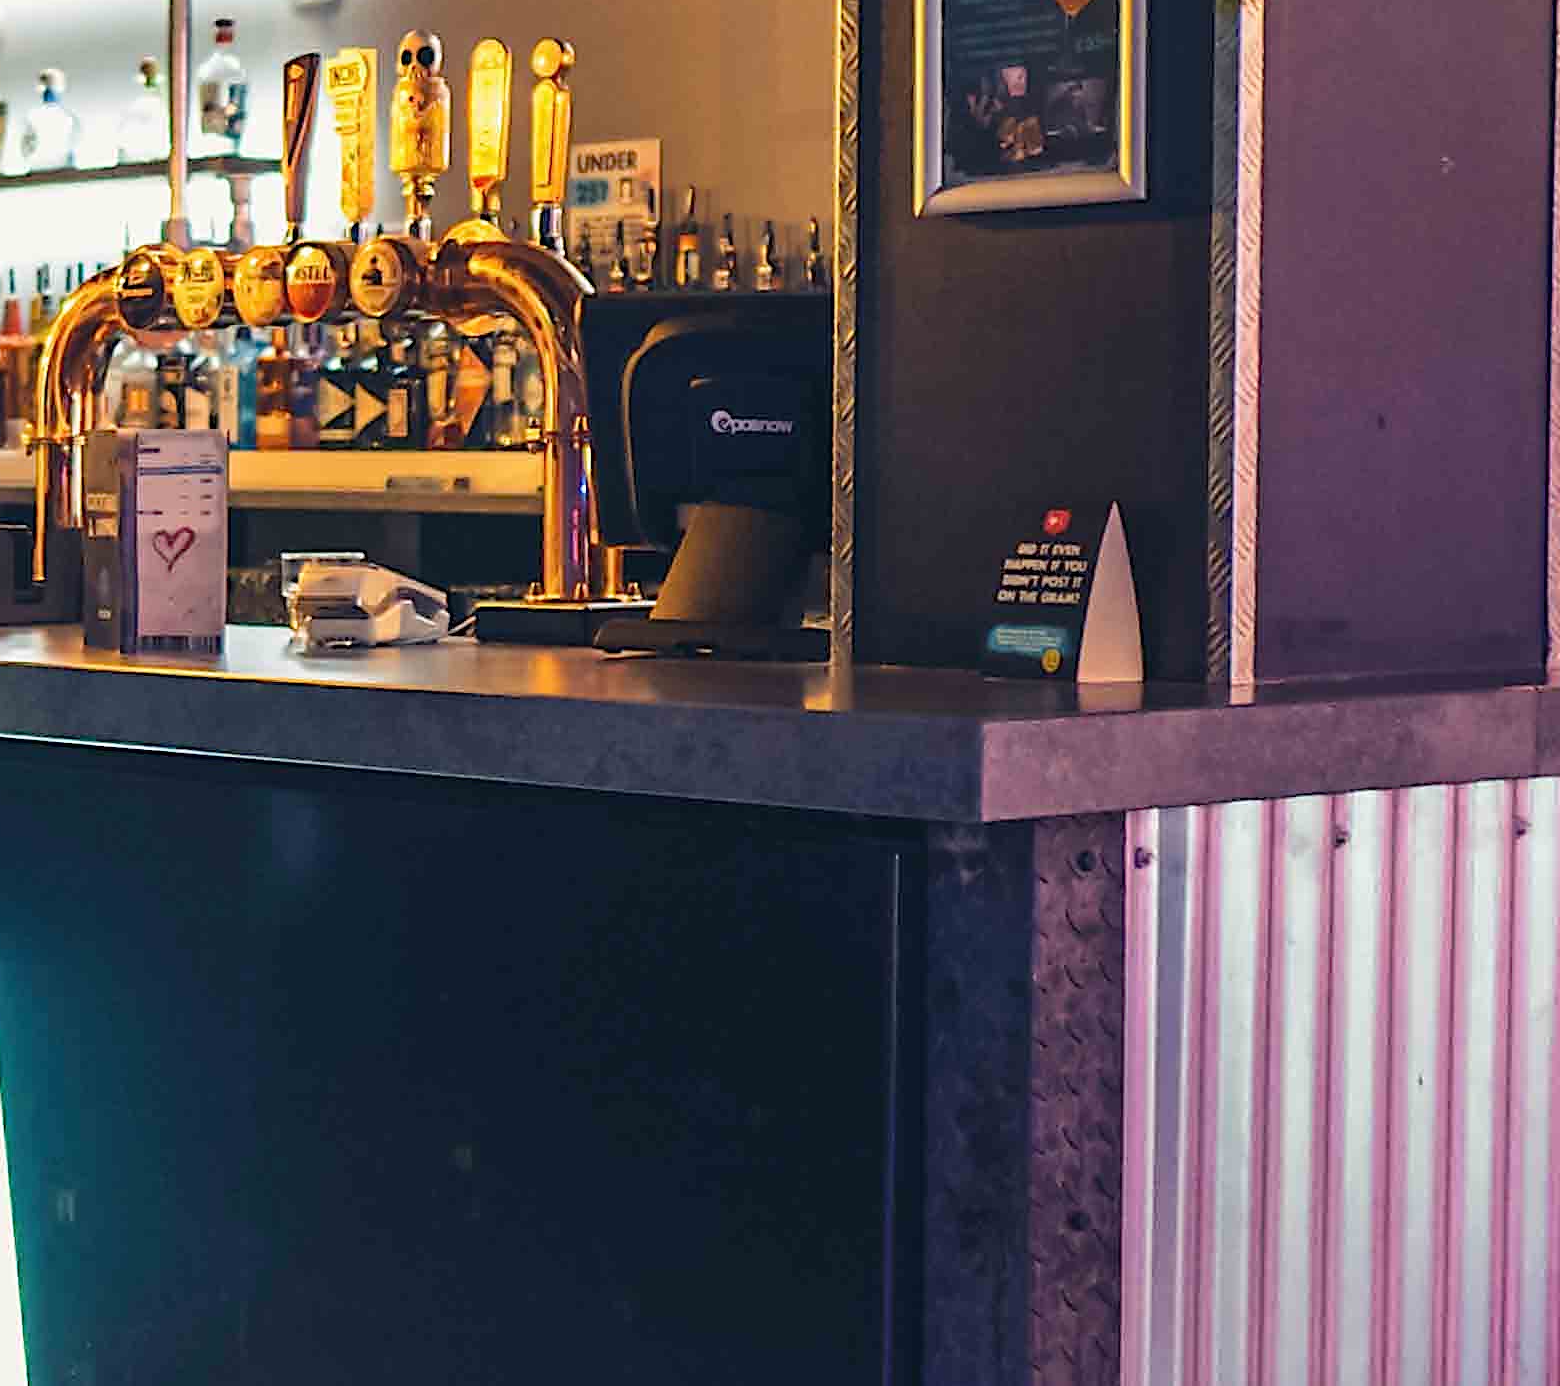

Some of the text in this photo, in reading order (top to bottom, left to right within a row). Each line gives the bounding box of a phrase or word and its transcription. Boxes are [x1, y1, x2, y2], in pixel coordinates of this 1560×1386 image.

[577, 150, 637, 173] UNDER
[1065, 560, 1088, 572] YOU
[1041, 576, 1070, 588] POST
[1072, 577, 1083, 588] IT
[997, 589, 1016, 602] ON
[1019, 590, 1038, 602] THE
